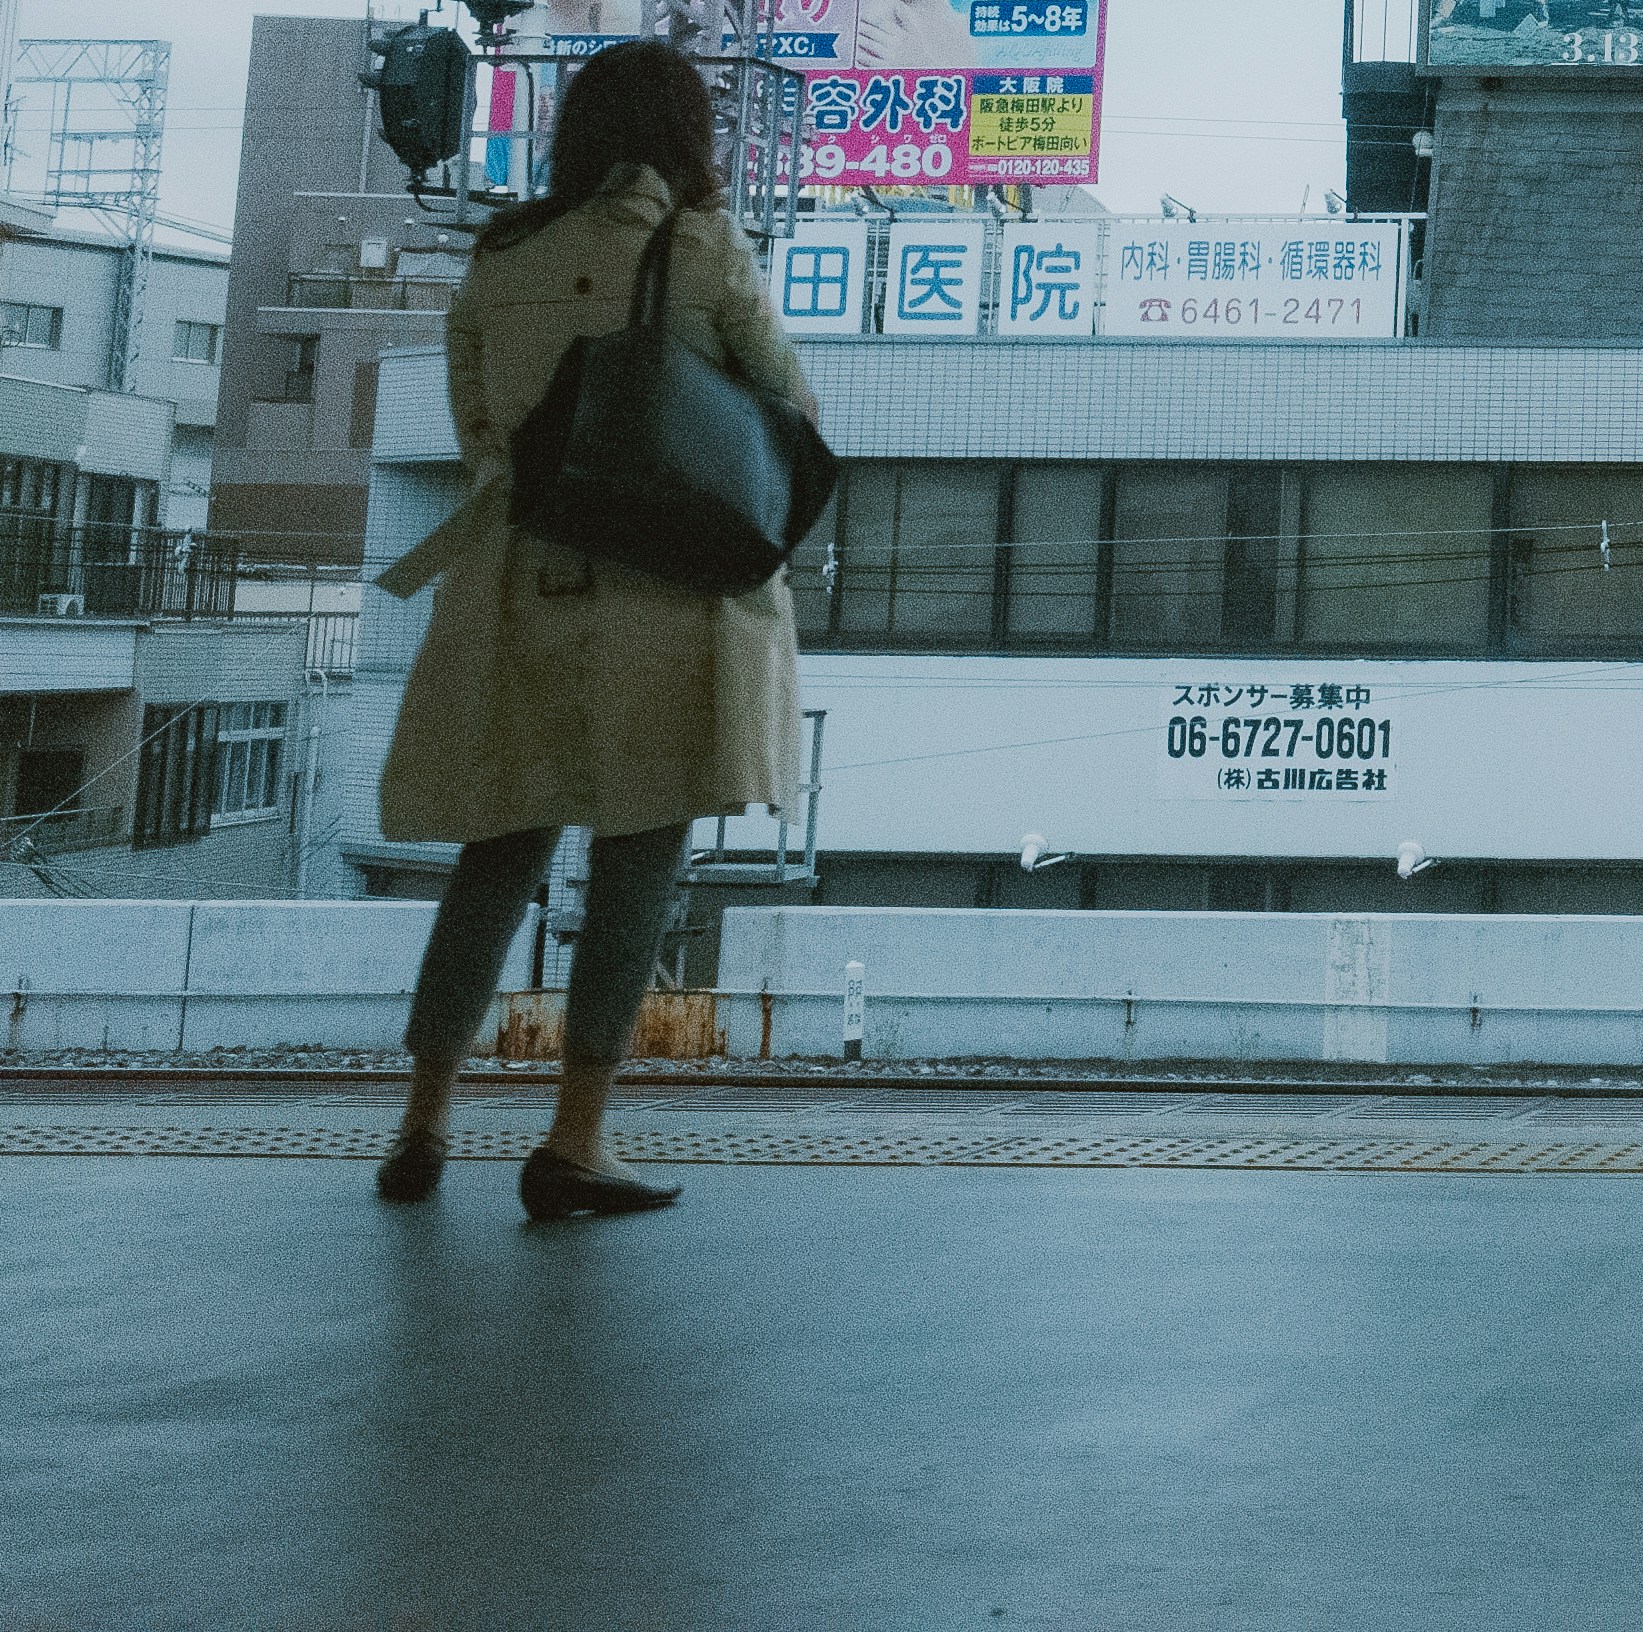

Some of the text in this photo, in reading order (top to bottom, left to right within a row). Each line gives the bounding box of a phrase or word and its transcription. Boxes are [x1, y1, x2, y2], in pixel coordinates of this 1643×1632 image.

[1562, 32, 1639, 63] 3.13
[999, 76, 1064, 94] 大阪院
[979, 98, 1083, 113] 阪急梅田駅より
[999, 116, 1056, 132] 徒歩5分
[1181, 297, 1362, 324] 6461-2471
[1172, 682, 1371, 709] スポンサー募集中
[1167, 716, 1391, 759] 06-6727-0601
